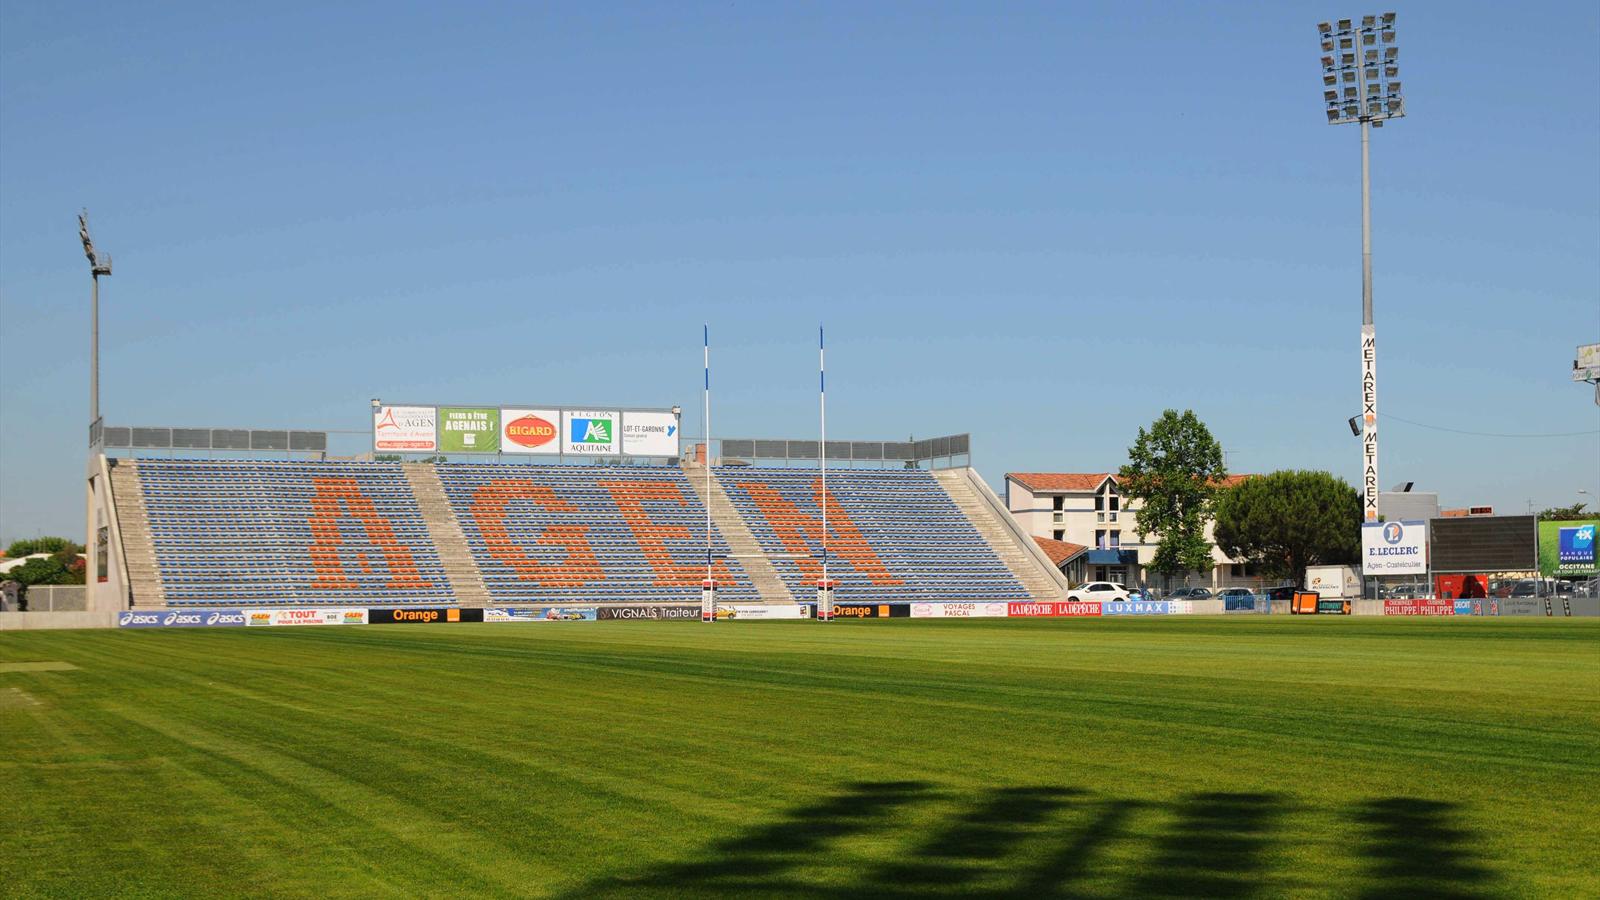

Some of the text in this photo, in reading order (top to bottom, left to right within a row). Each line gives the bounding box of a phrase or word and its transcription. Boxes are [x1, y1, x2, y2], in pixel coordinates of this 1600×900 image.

[1363, 338, 1375, 413] METAREX
[445, 421, 488, 431] AGENAIS
[509, 425, 552, 436] BIGARD
[623, 425, 665, 433] LOT-ET-GARONNE
[571, 444, 613, 453] AQUITAINE
[1364, 432, 1377, 508] METAREX
[1369, 546, 1419, 556] E.LECLERC
[833, 605, 871, 618] Orange
[1107, 603, 1163, 612] LUXMAX
[1385, 606, 1418, 615] PHILIPPE
[1420, 606, 1453, 615] PHILIPPE
[289, 611, 317, 619] TOUT
[393, 609, 438, 622] Orange
[611, 608, 700, 618] VIGNALS Traiteur
[132, 615, 159, 624] asics
[176, 615, 202, 624] asics
[219, 614, 244, 623] asics
